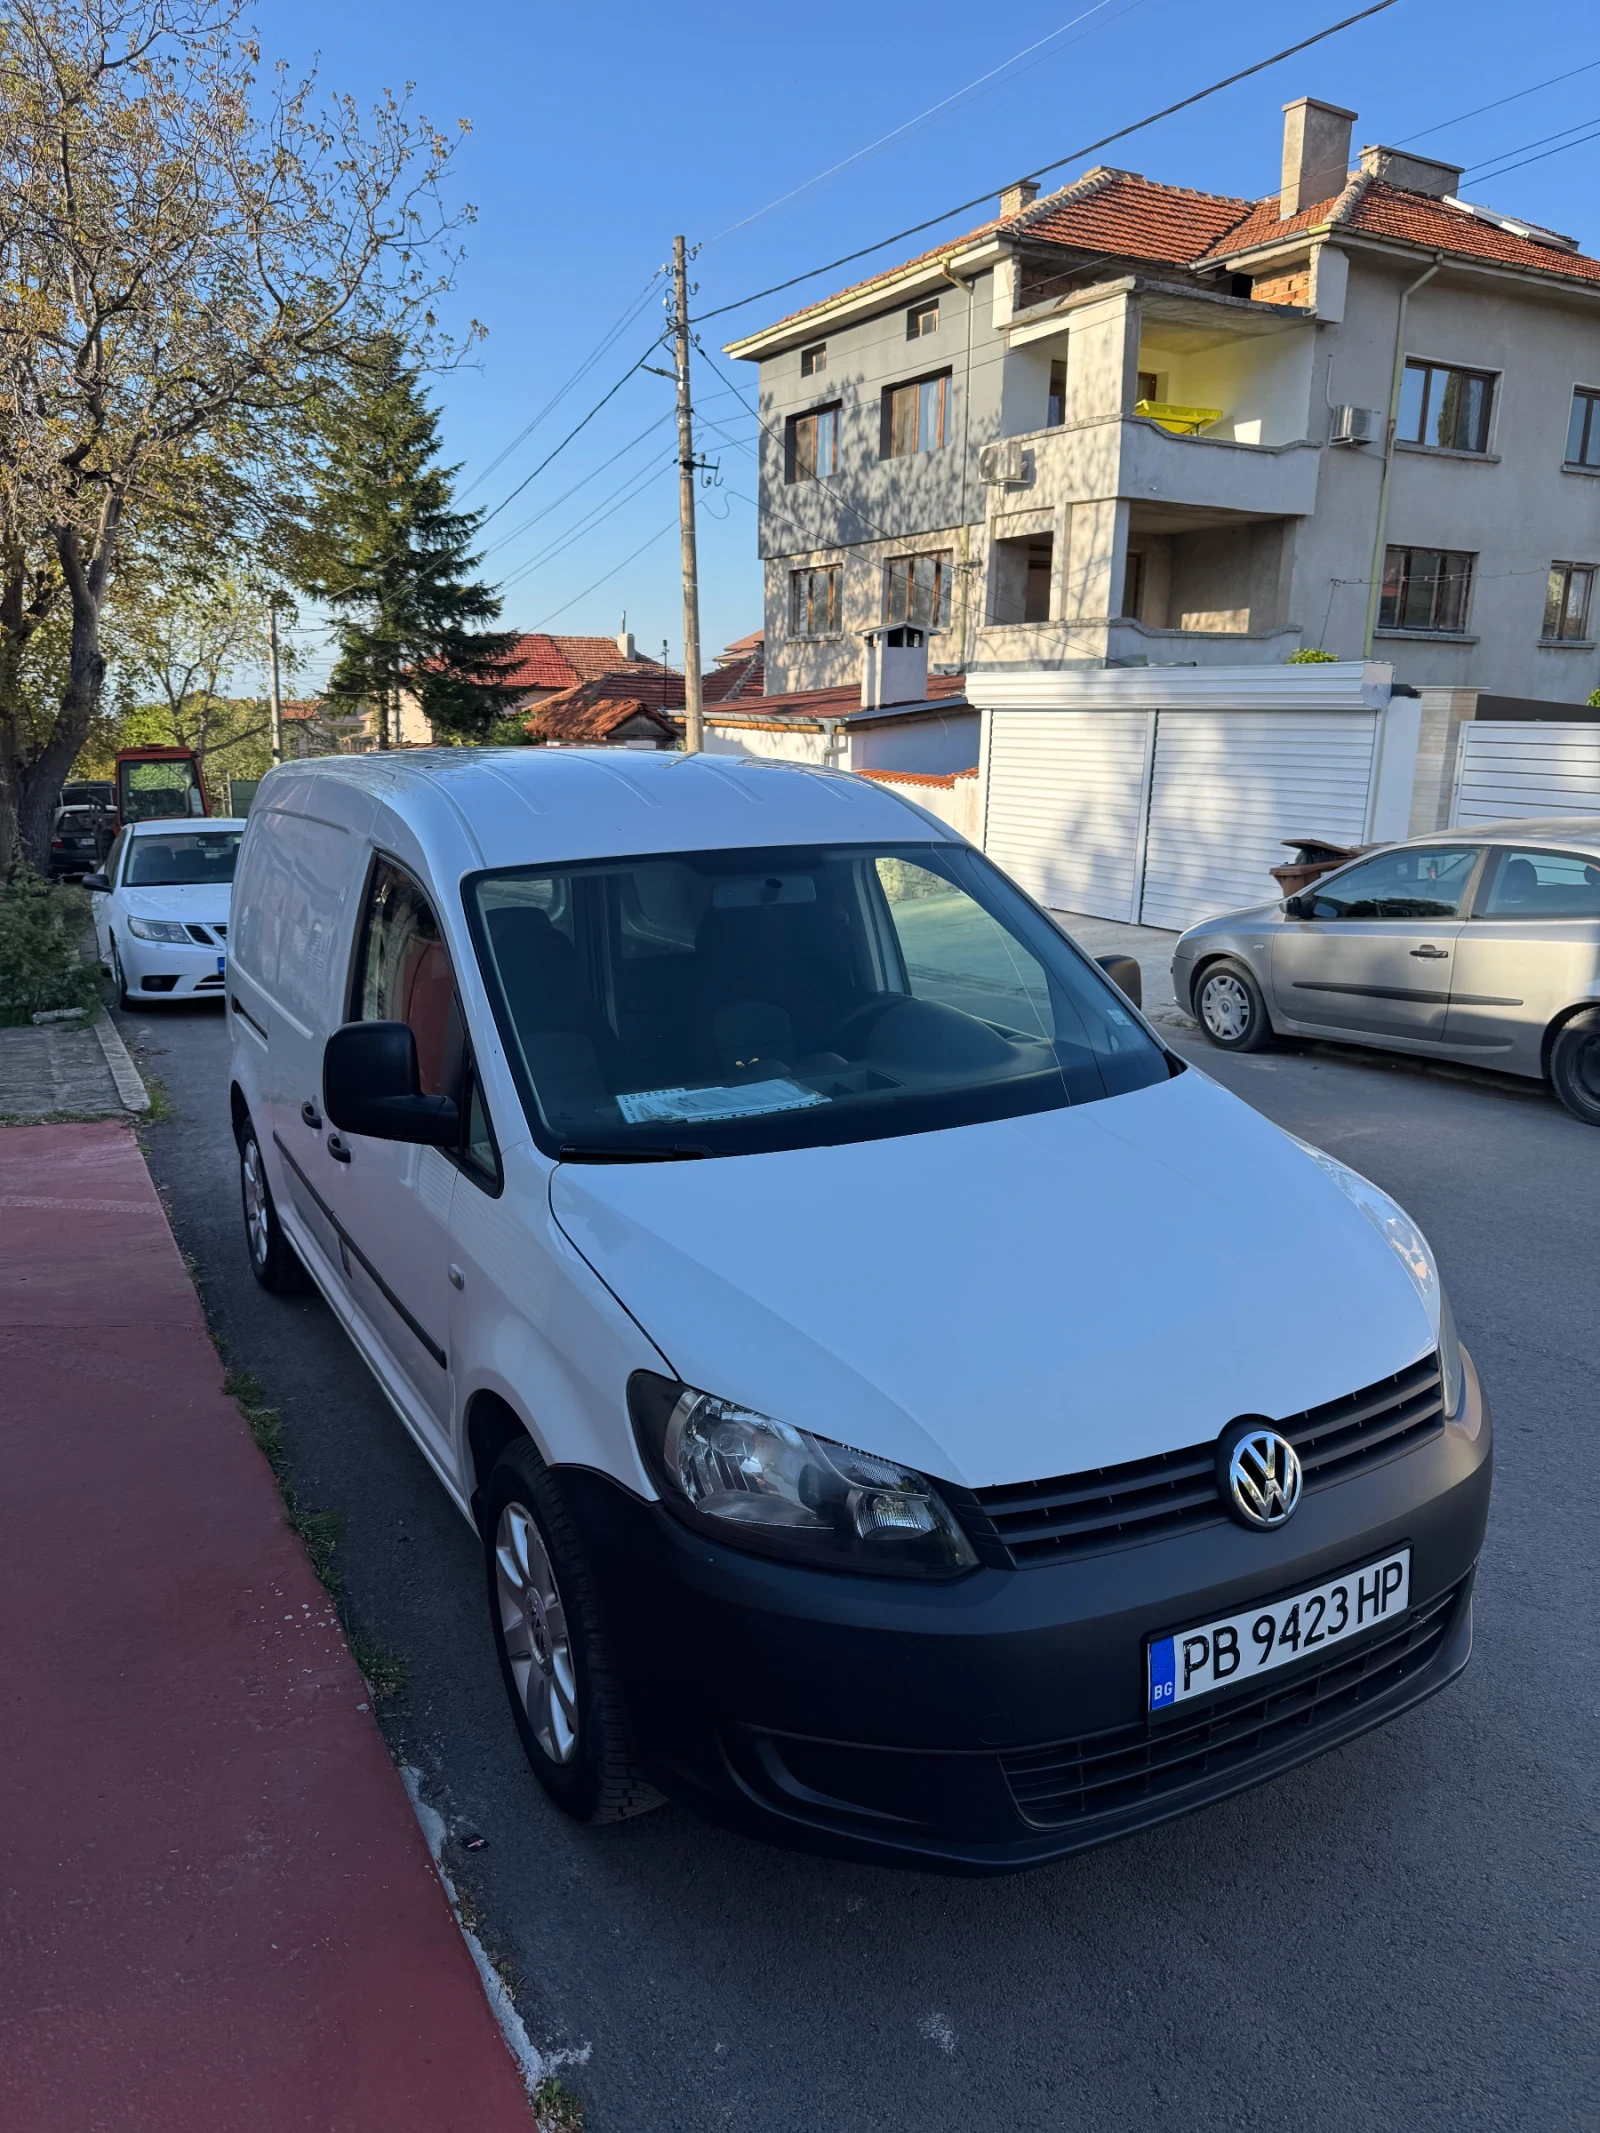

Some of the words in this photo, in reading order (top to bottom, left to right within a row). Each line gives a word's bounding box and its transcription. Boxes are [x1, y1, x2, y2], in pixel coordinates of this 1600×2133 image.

[1230, 1431, 1302, 1523] VW
[1183, 1625, 1241, 1691] PB
[1252, 1586, 1348, 1665] 9423
[1357, 1561, 1403, 1624] HP
[1154, 1681, 1173, 1700] BG
